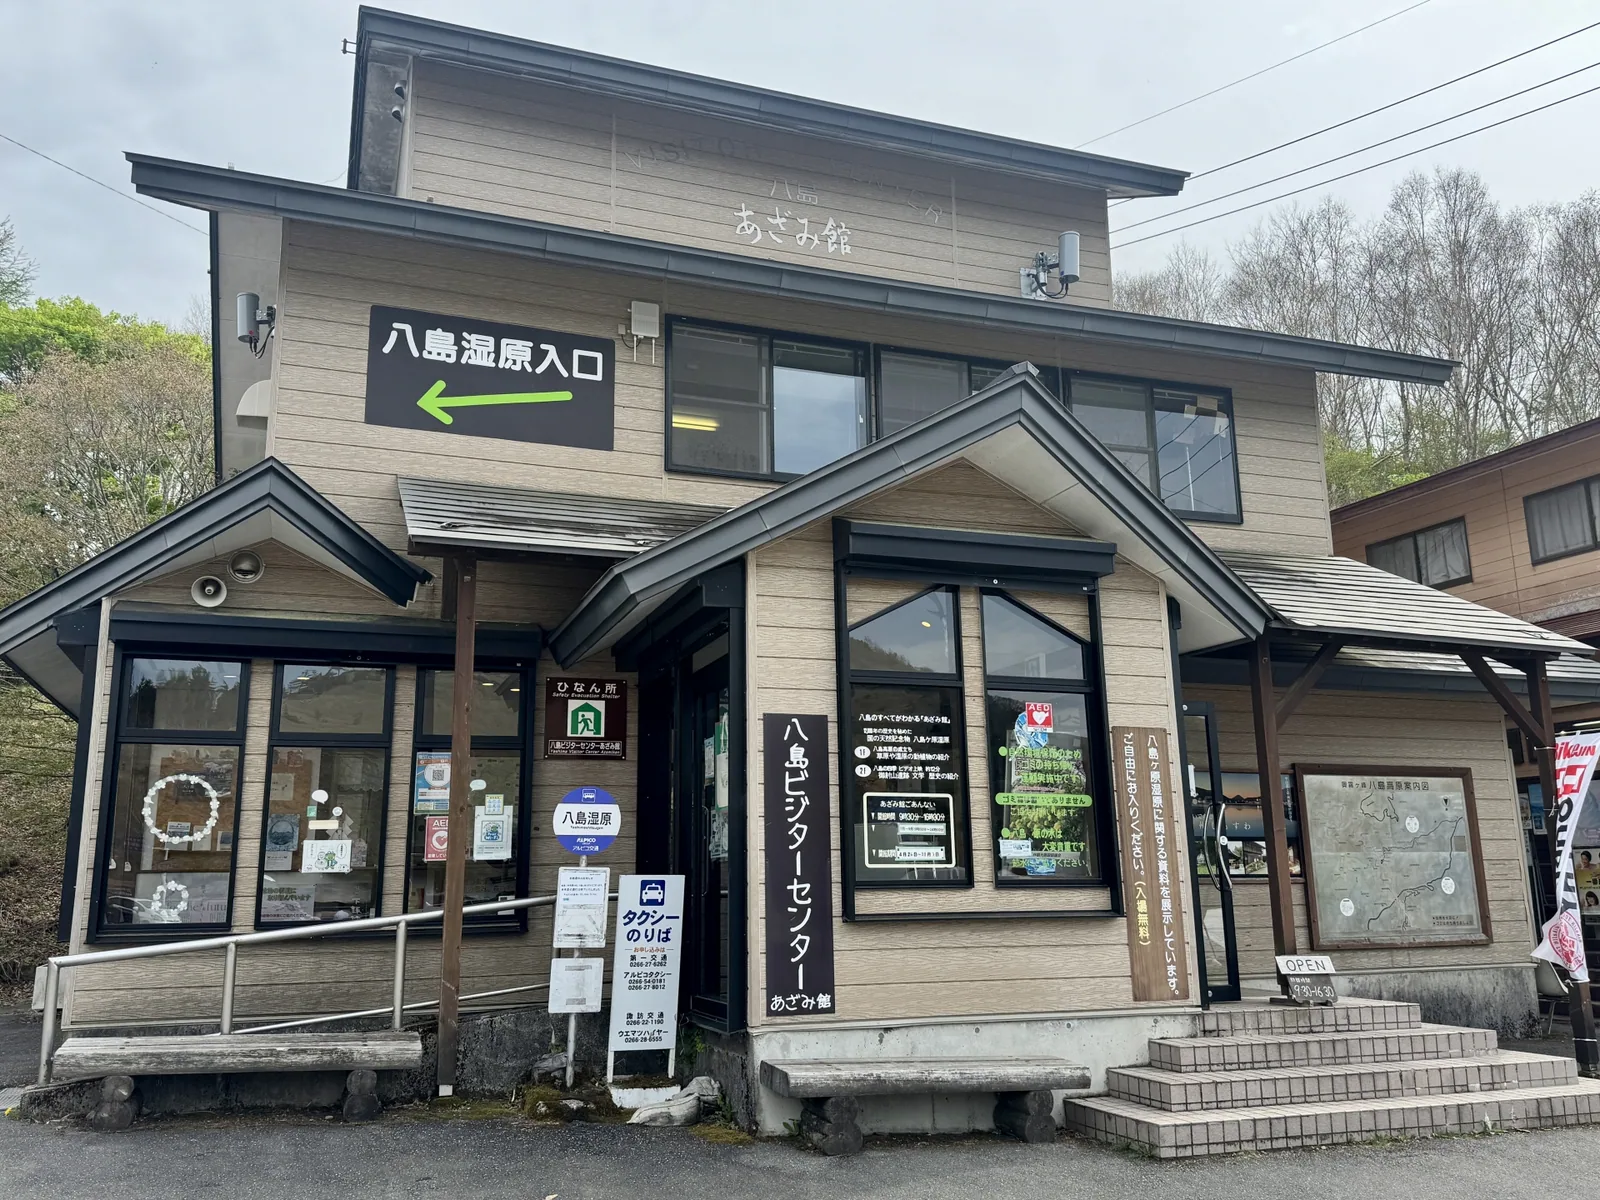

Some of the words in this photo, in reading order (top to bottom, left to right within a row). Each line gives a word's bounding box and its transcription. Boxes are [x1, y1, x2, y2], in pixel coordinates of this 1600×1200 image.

[769, 178, 819, 205] 八島
[733, 202, 852, 256] あざみ館
[382, 321, 603, 382] 八島湿原入口
[556, 682, 618, 694] ひなん所
[1028, 703, 1050, 712] AED
[1369, 781, 1429, 791] 八島高原案内図
[879, 800, 936, 808] あざみ館ごあんない
[432, 819, 448, 827] AE
[562, 811, 613, 826] 八島湿原
[783, 717, 812, 991] 八島ビジターセンター
[622, 909, 680, 927] タクシー
[626, 927, 672, 943] のりば
[630, 954, 668, 962] 第一交通
[1285, 959, 1326, 972] OPEN
[623, 971, 672, 979] アルピコタクシー
[770, 992, 832, 1012] あざみ館
[626, 1012, 665, 1020] 諏訪交通
[617, 1029, 669, 1038] ウエマツハイヤー
